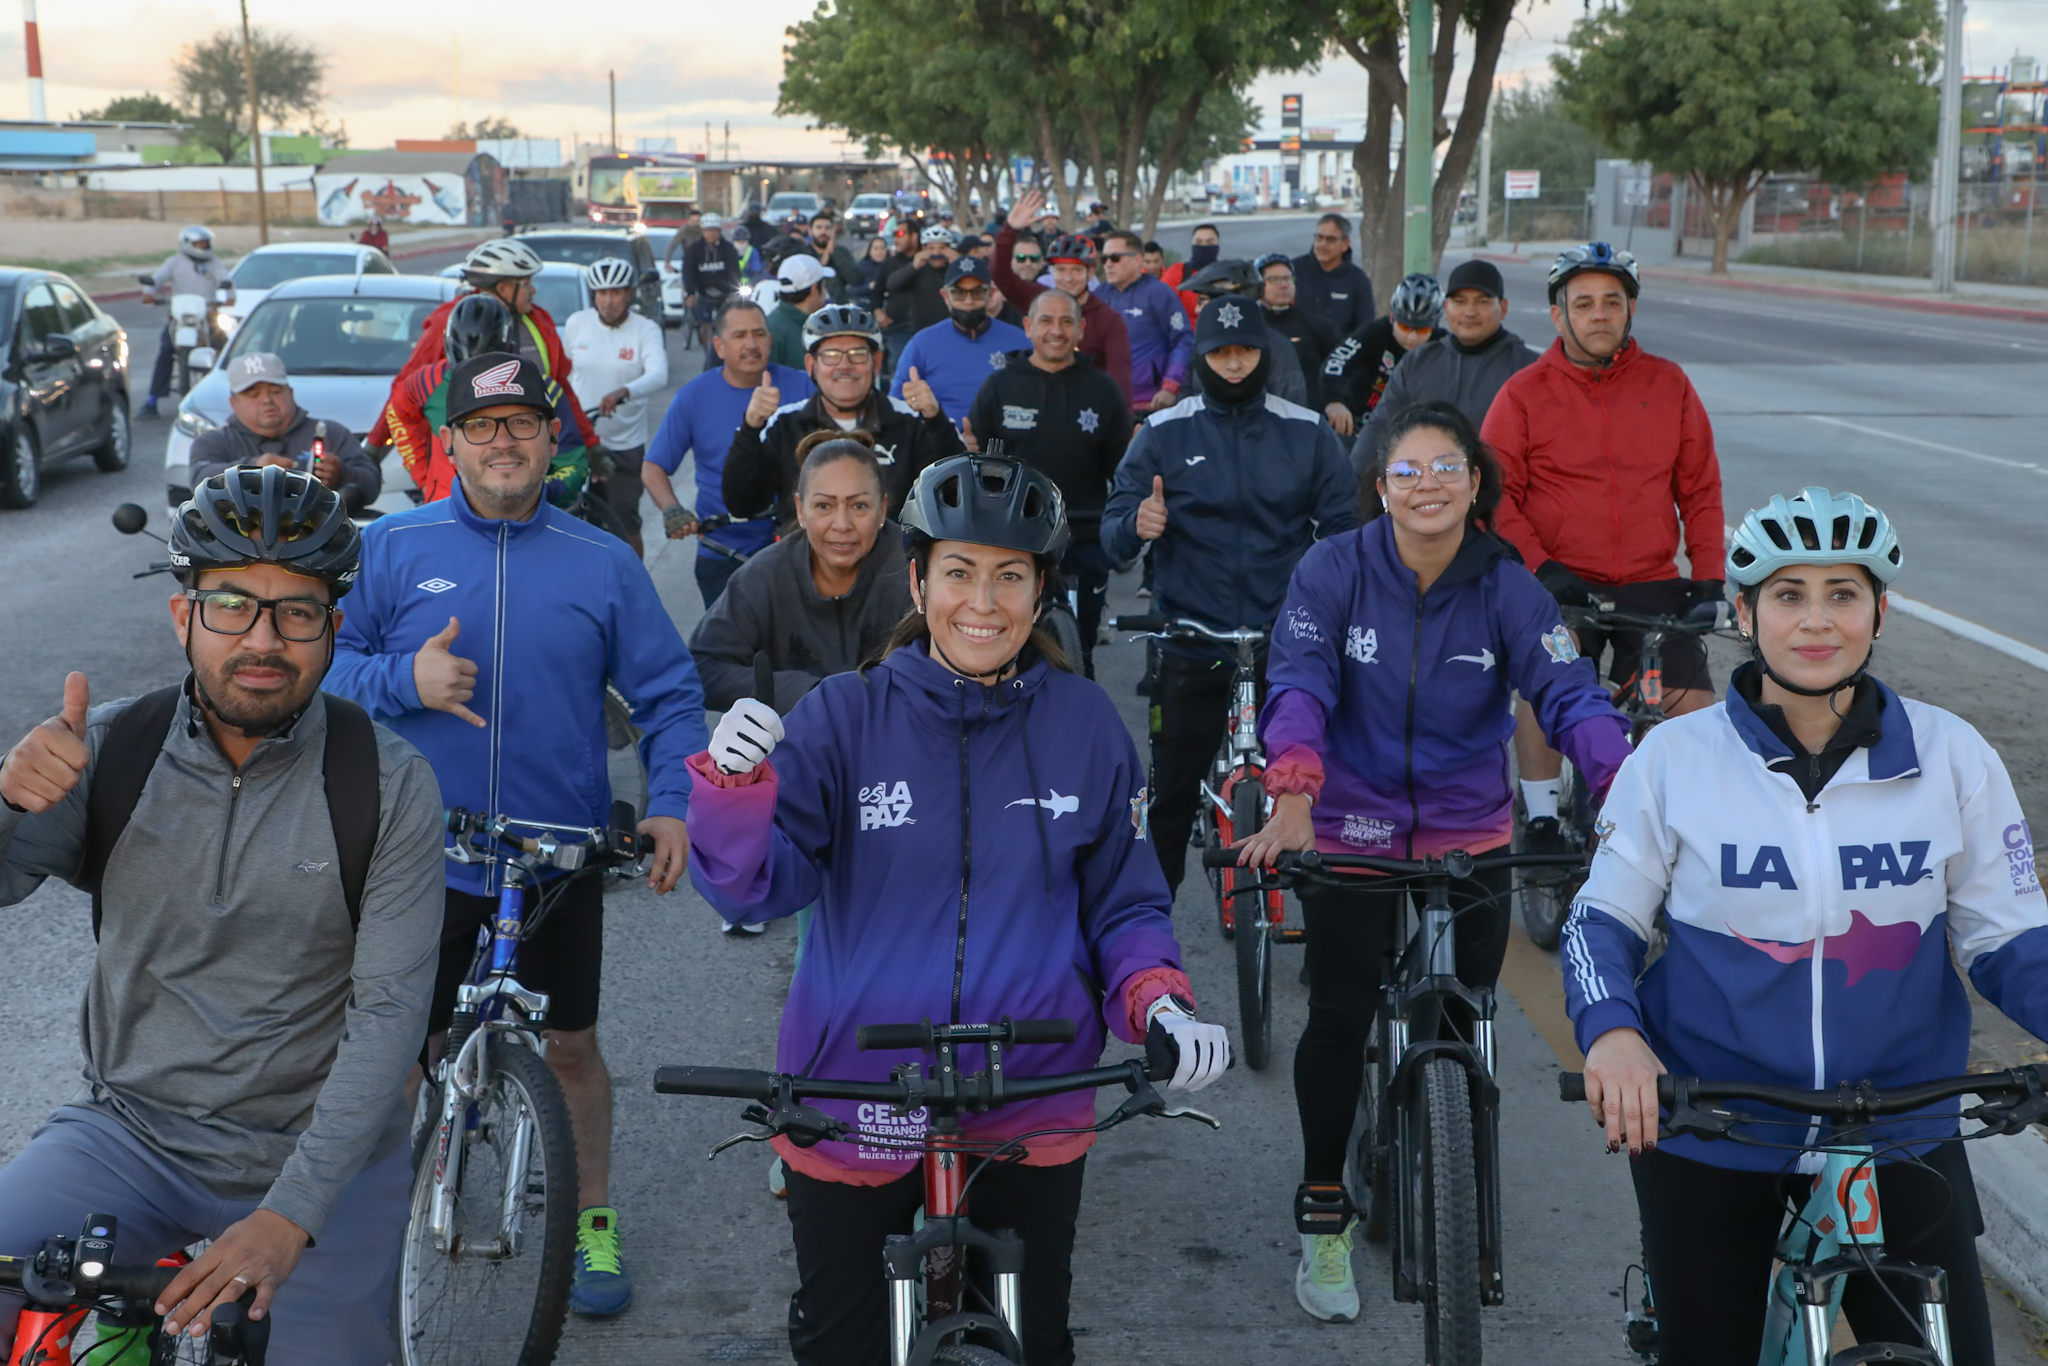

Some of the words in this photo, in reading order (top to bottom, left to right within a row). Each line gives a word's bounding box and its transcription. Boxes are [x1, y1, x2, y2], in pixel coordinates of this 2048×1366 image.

[477, 386, 520, 395] HONDA
[1345, 637, 1380, 664] PAZ
[860, 803, 918, 831] PAZ
[1721, 843, 1798, 890] LA
[1838, 840, 1934, 891] PAZ
[858, 1124, 927, 1135] TOLERANCIA
[858, 1151, 896, 1160] MUJERES
